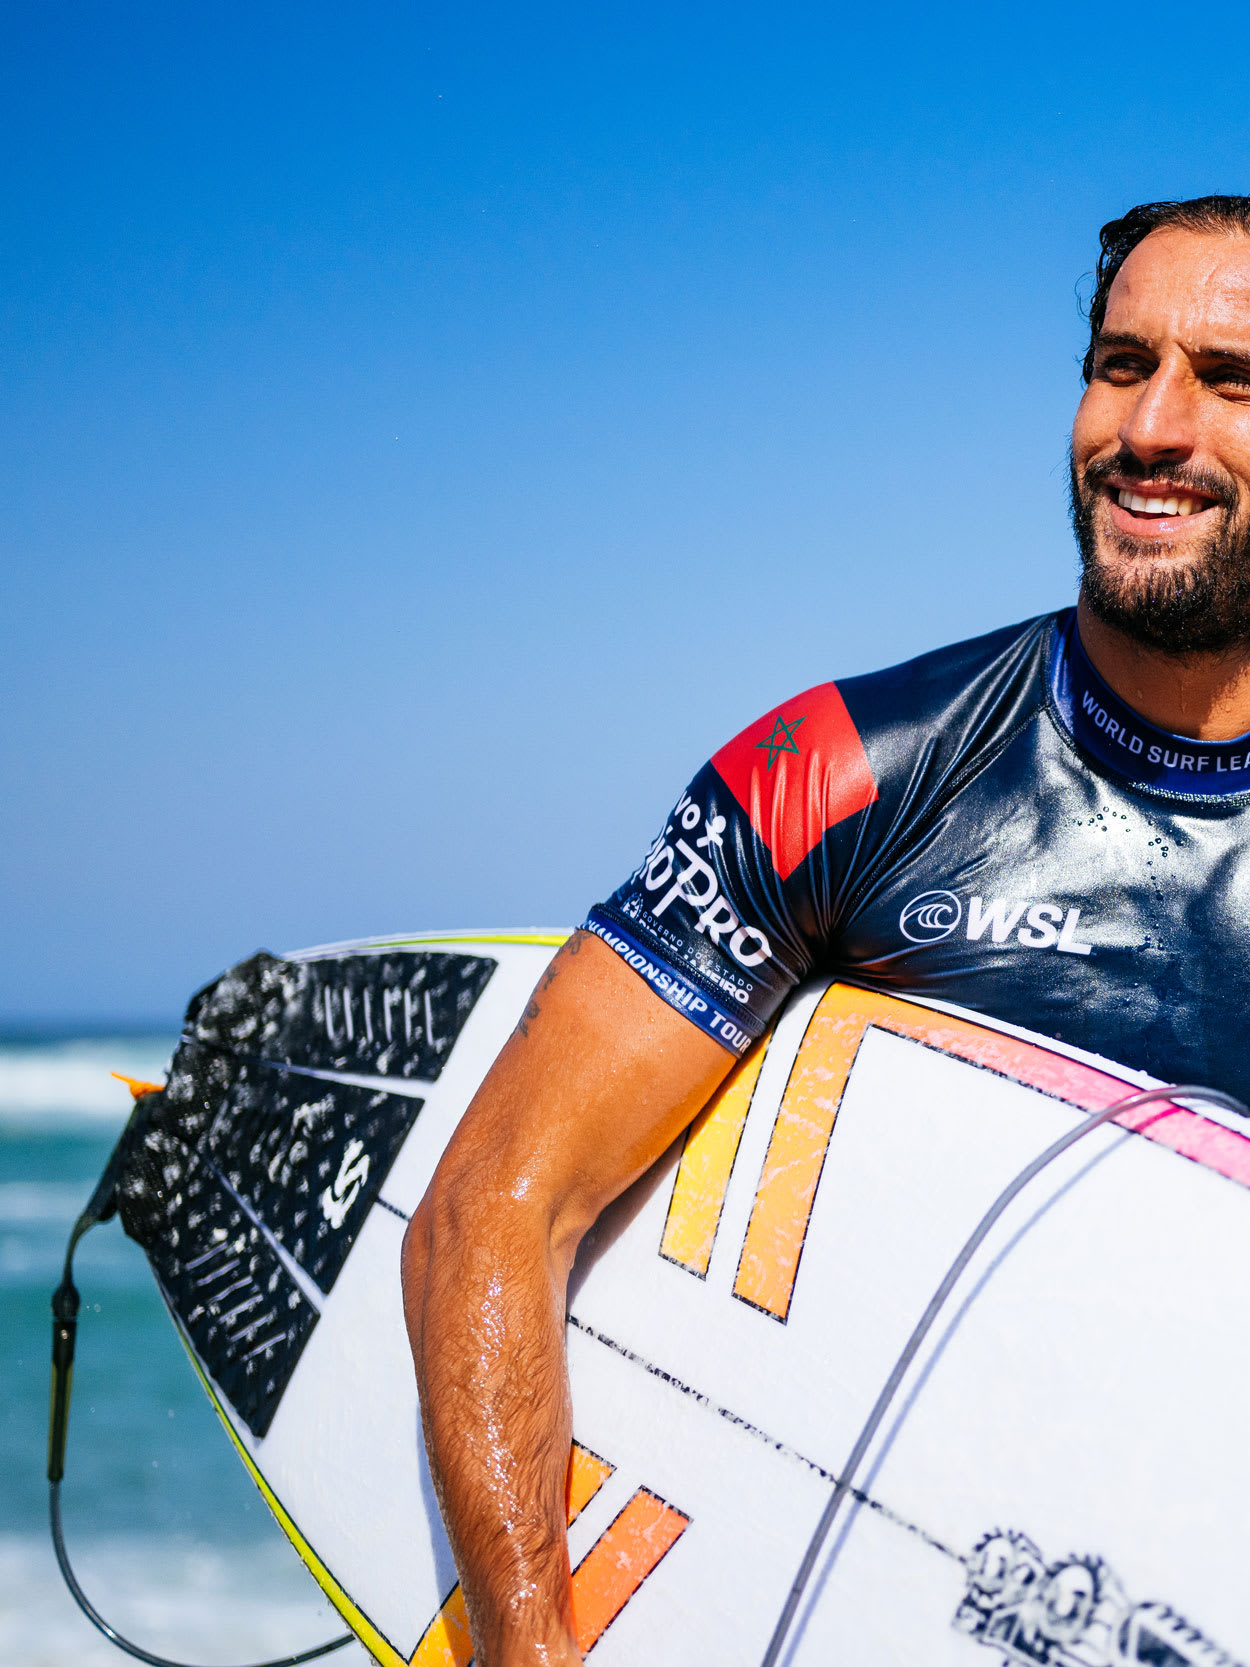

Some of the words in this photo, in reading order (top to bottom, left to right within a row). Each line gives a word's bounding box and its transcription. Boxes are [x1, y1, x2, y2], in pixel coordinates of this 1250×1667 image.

[1081, 690, 1144, 754] WORLD
[1147, 745, 1209, 772] SURF
[642, 911, 683, 947] GOVERNO
[687, 946, 702, 959] DO
[706, 959, 753, 991] ESTADO
[966, 896, 1093, 956] WSL
[709, 1010, 752, 1054] TOUR
